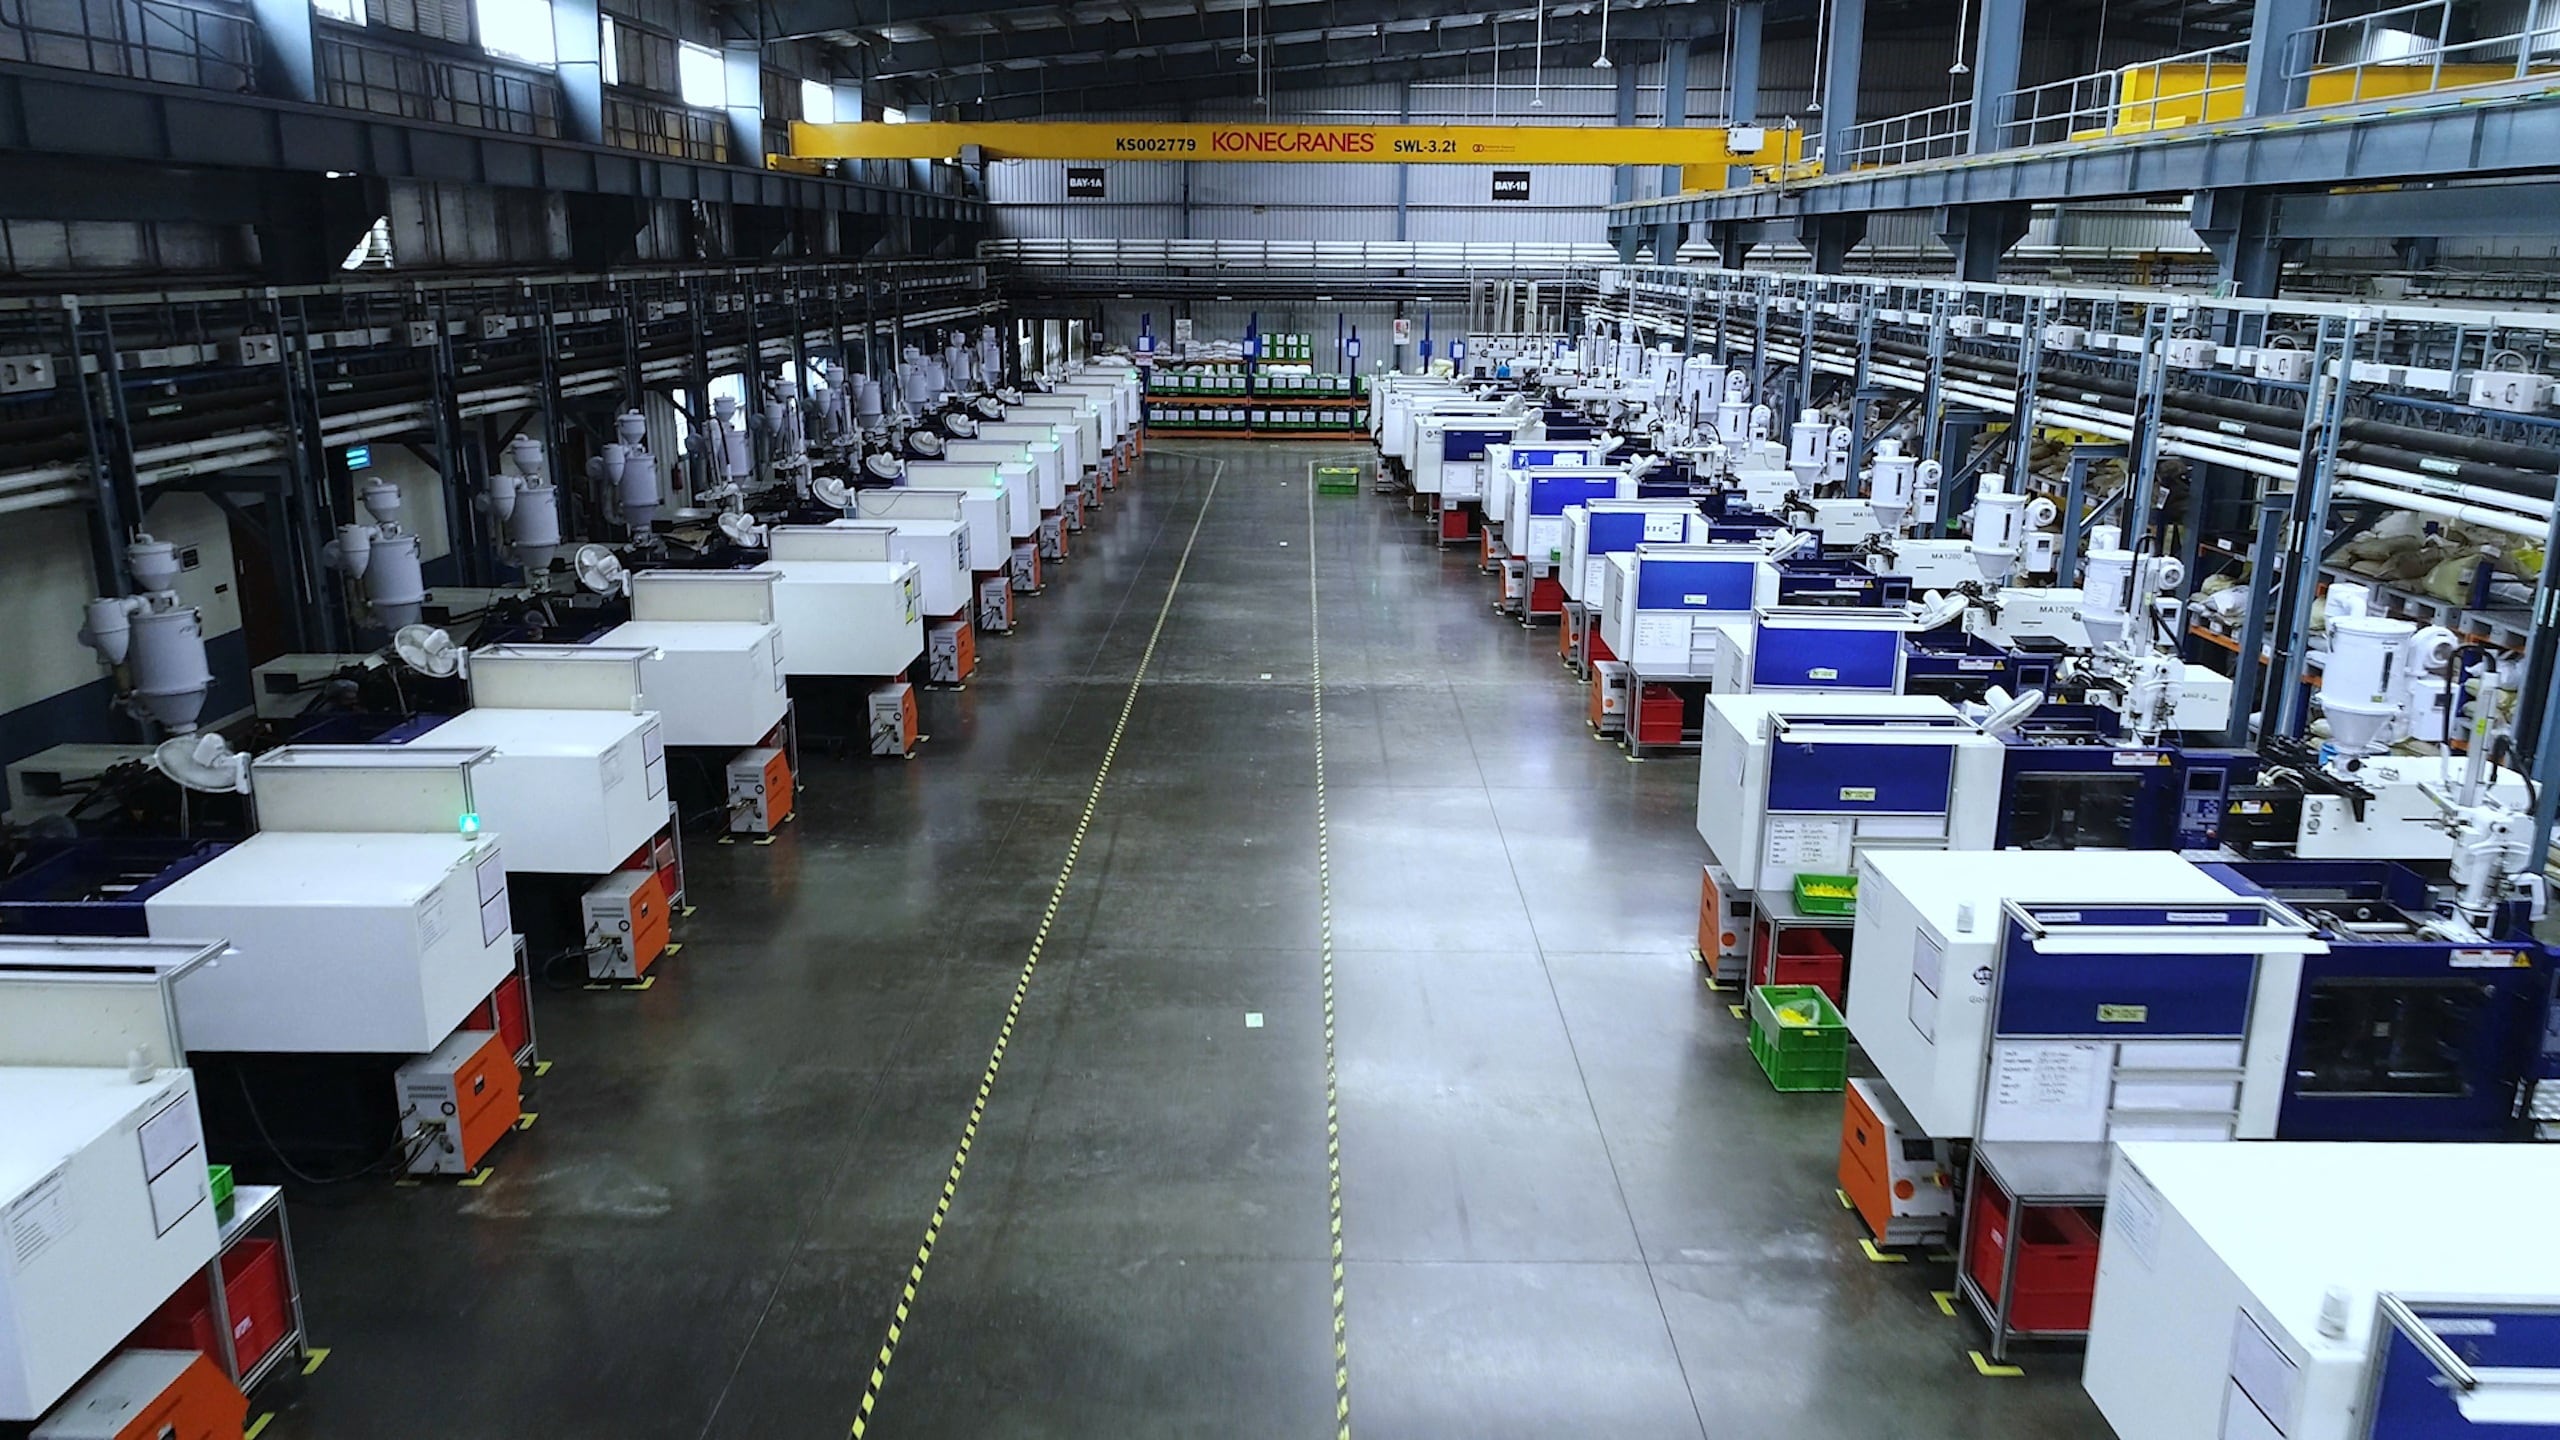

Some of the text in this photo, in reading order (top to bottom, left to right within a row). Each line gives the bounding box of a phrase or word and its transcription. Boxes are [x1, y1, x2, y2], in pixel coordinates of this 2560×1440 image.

[1116, 132, 1456, 153] KS002779 KONECRANES SWL-3.2t
[1070, 178, 1102, 187] BAY-1A
[1494, 181, 1528, 191] BAY-1B
[2039, 605, 2075, 614] MA1200
